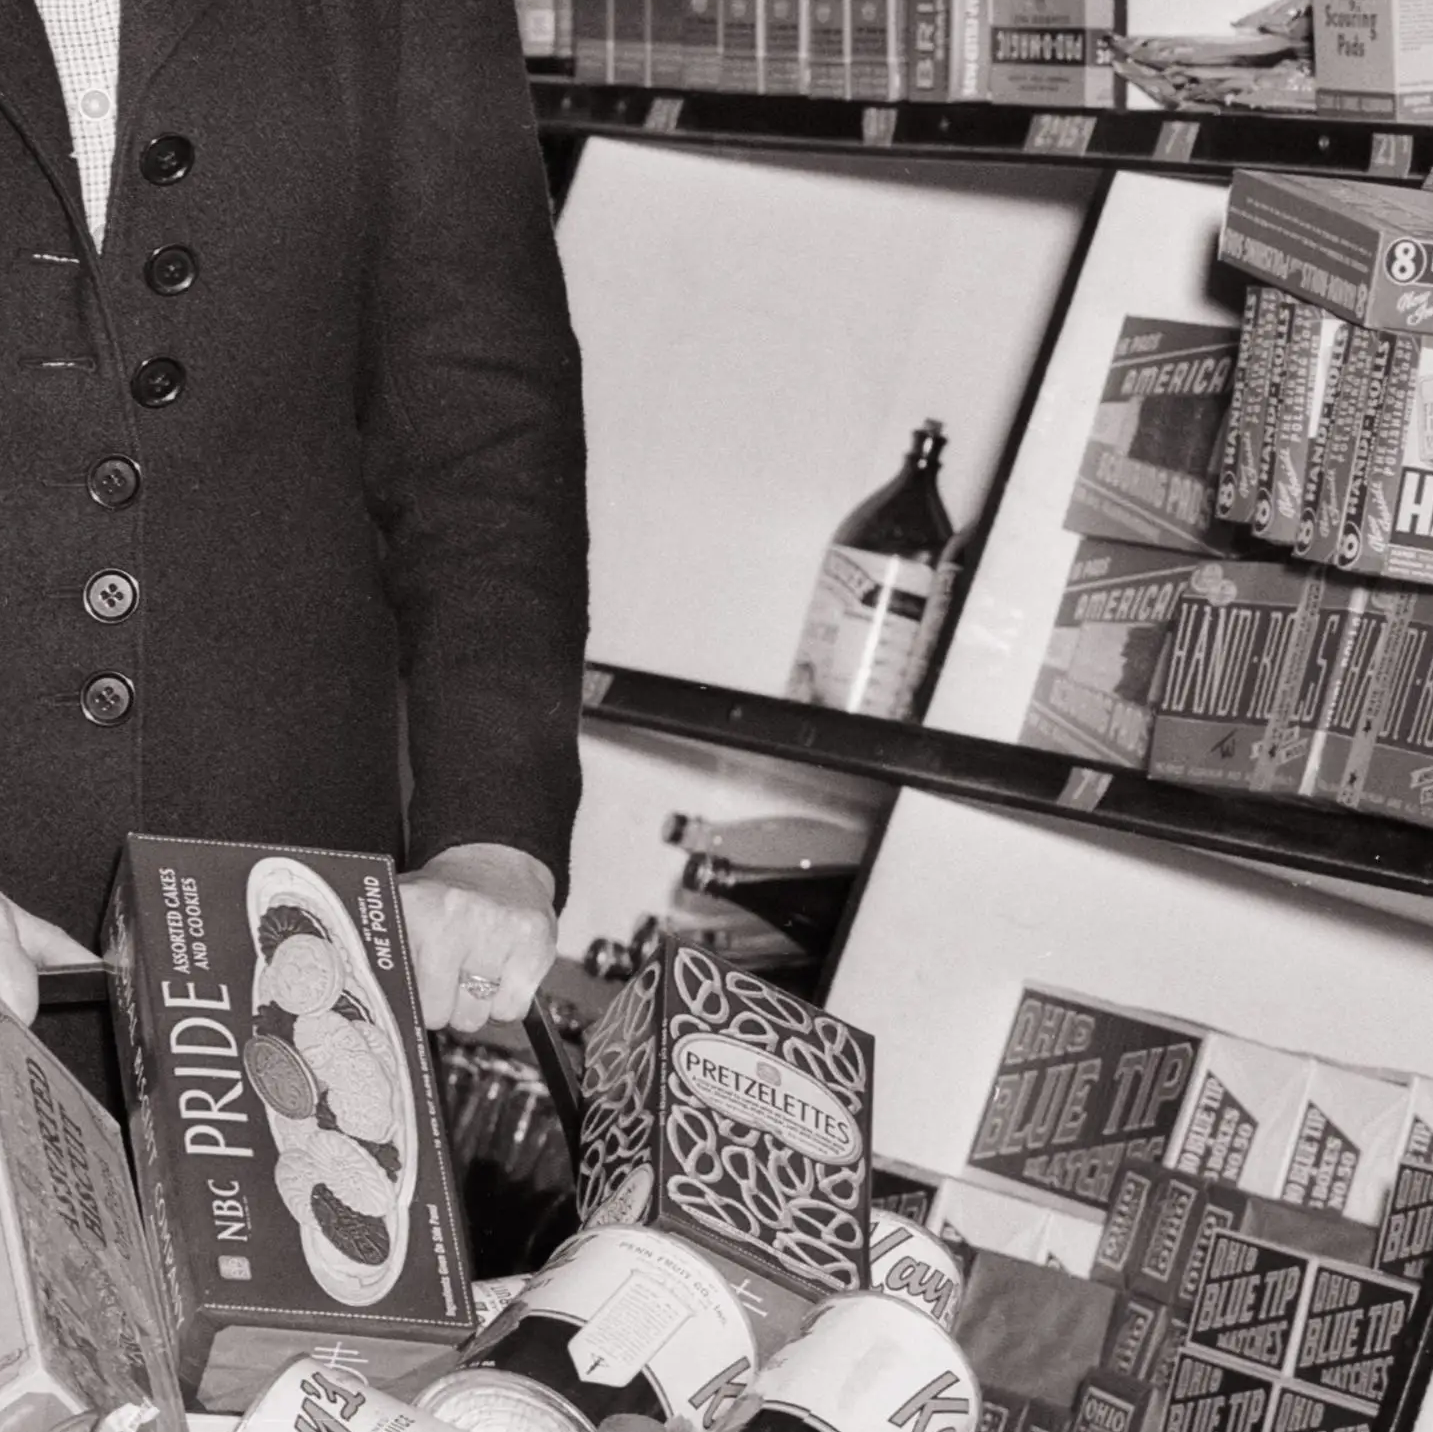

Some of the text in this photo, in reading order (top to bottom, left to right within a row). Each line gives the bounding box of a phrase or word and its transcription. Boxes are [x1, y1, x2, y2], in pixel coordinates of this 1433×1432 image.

[1387, 242, 1424, 278] 8
[162, 869, 186, 975] ASSORTED CAKES
[181, 878, 207, 971] AND COOKIES
[365, 876, 394, 971] ONE POUND
[166, 981, 254, 1161] PRIDE
[684, 1051, 852, 1144] PRETZELETTES
[215, 1182, 244, 1240] NBC
[1203, 1272, 1300, 1333] BLUE TIP
[1365, 1315, 1406, 1358] TIP
